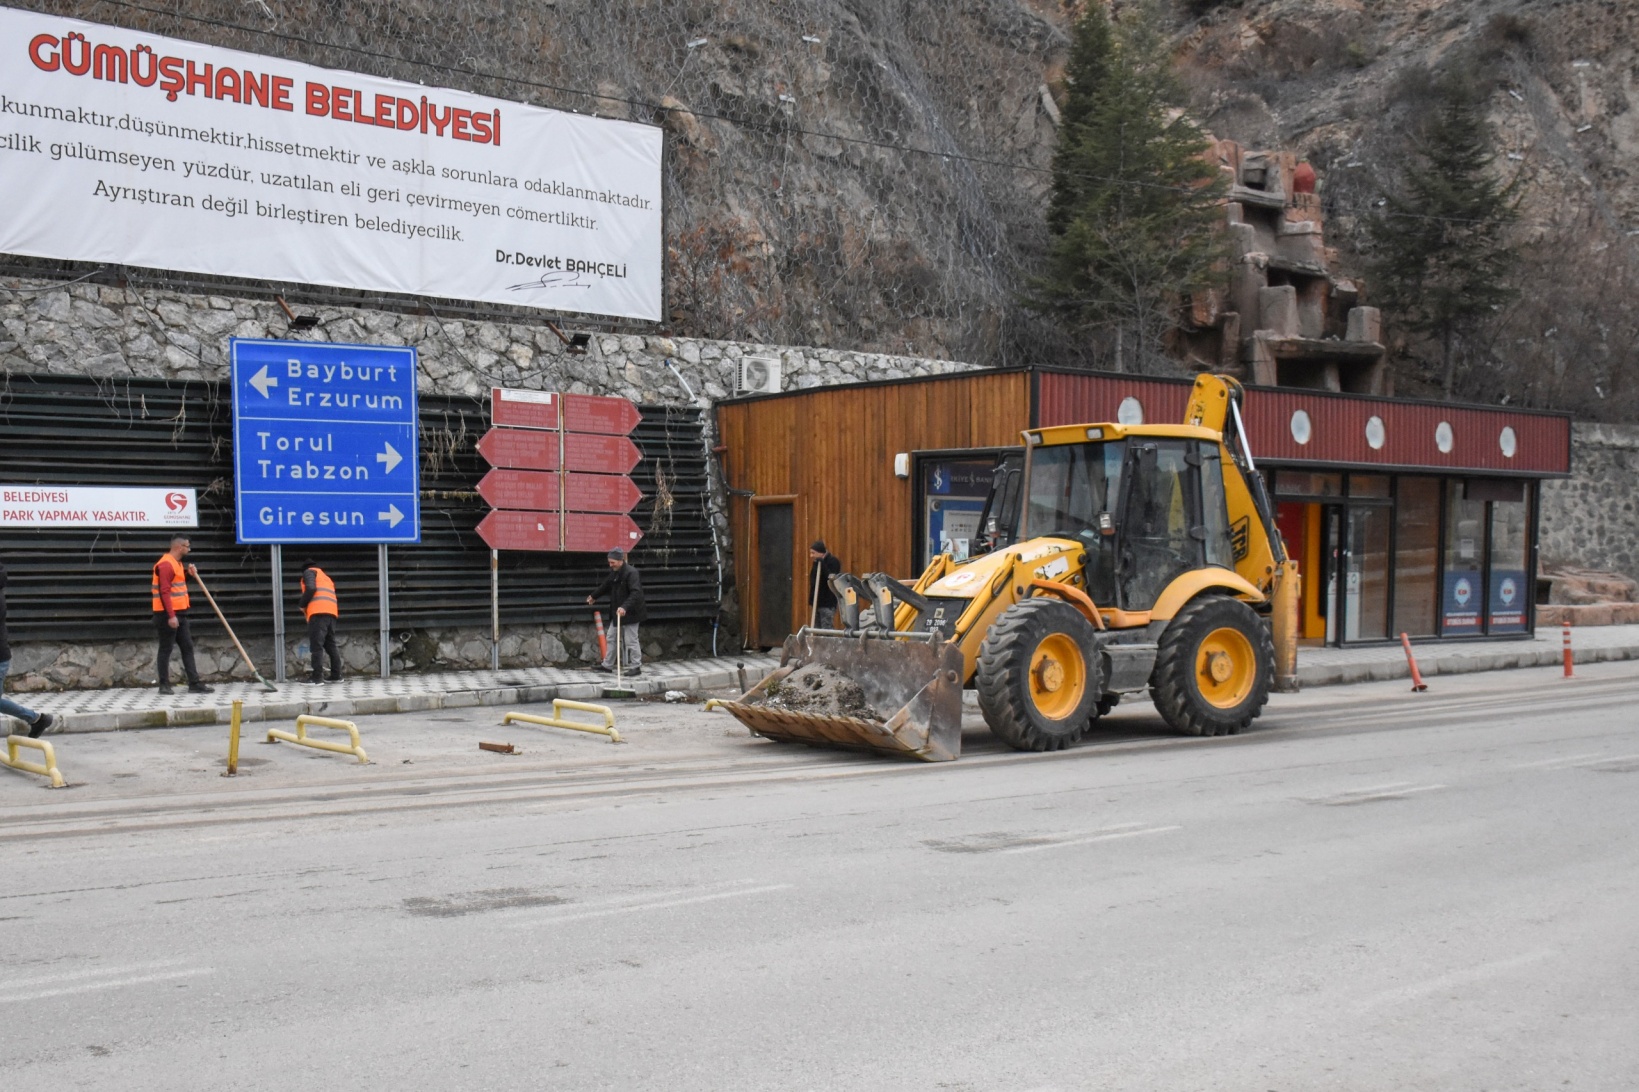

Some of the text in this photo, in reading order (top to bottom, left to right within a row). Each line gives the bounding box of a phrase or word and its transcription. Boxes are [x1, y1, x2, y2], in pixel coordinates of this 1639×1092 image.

[28, 31, 501, 146] GÜMÜŞHANE BELEDİYESİ
[50, 142, 176, 172] gülümseyen
[183, 161, 254, 185] yüzdür,
[260, 172, 334, 194] uzatılan
[340, 181, 361, 197] eli
[367, 186, 400, 203] geri
[406, 193, 501, 217] çevirmeyen
[506, 204, 598, 230] cömertliktir.
[366, 155, 386, 169] ve
[392, 158, 436, 177] aşkla
[441, 168, 519, 189] sorunlara
[523, 177, 653, 210] odaklanmaktadır.
[93, 180, 464, 242] Ayrıştıran değil birleştiren belediyecilik.
[495, 249, 627, 279] Dr.Devlet BAHÇELİ
[287, 359, 396, 383] Bayburt
[288, 387, 403, 409] Erzurum
[257, 431, 332, 451] Torul
[258, 460, 369, 480] Trabzon
[3, 489, 69, 503] BELEDİYESİ
[3, 510, 150, 522] PARK YAPMAK YASAKTIR.
[259, 506, 364, 526] Giresun
